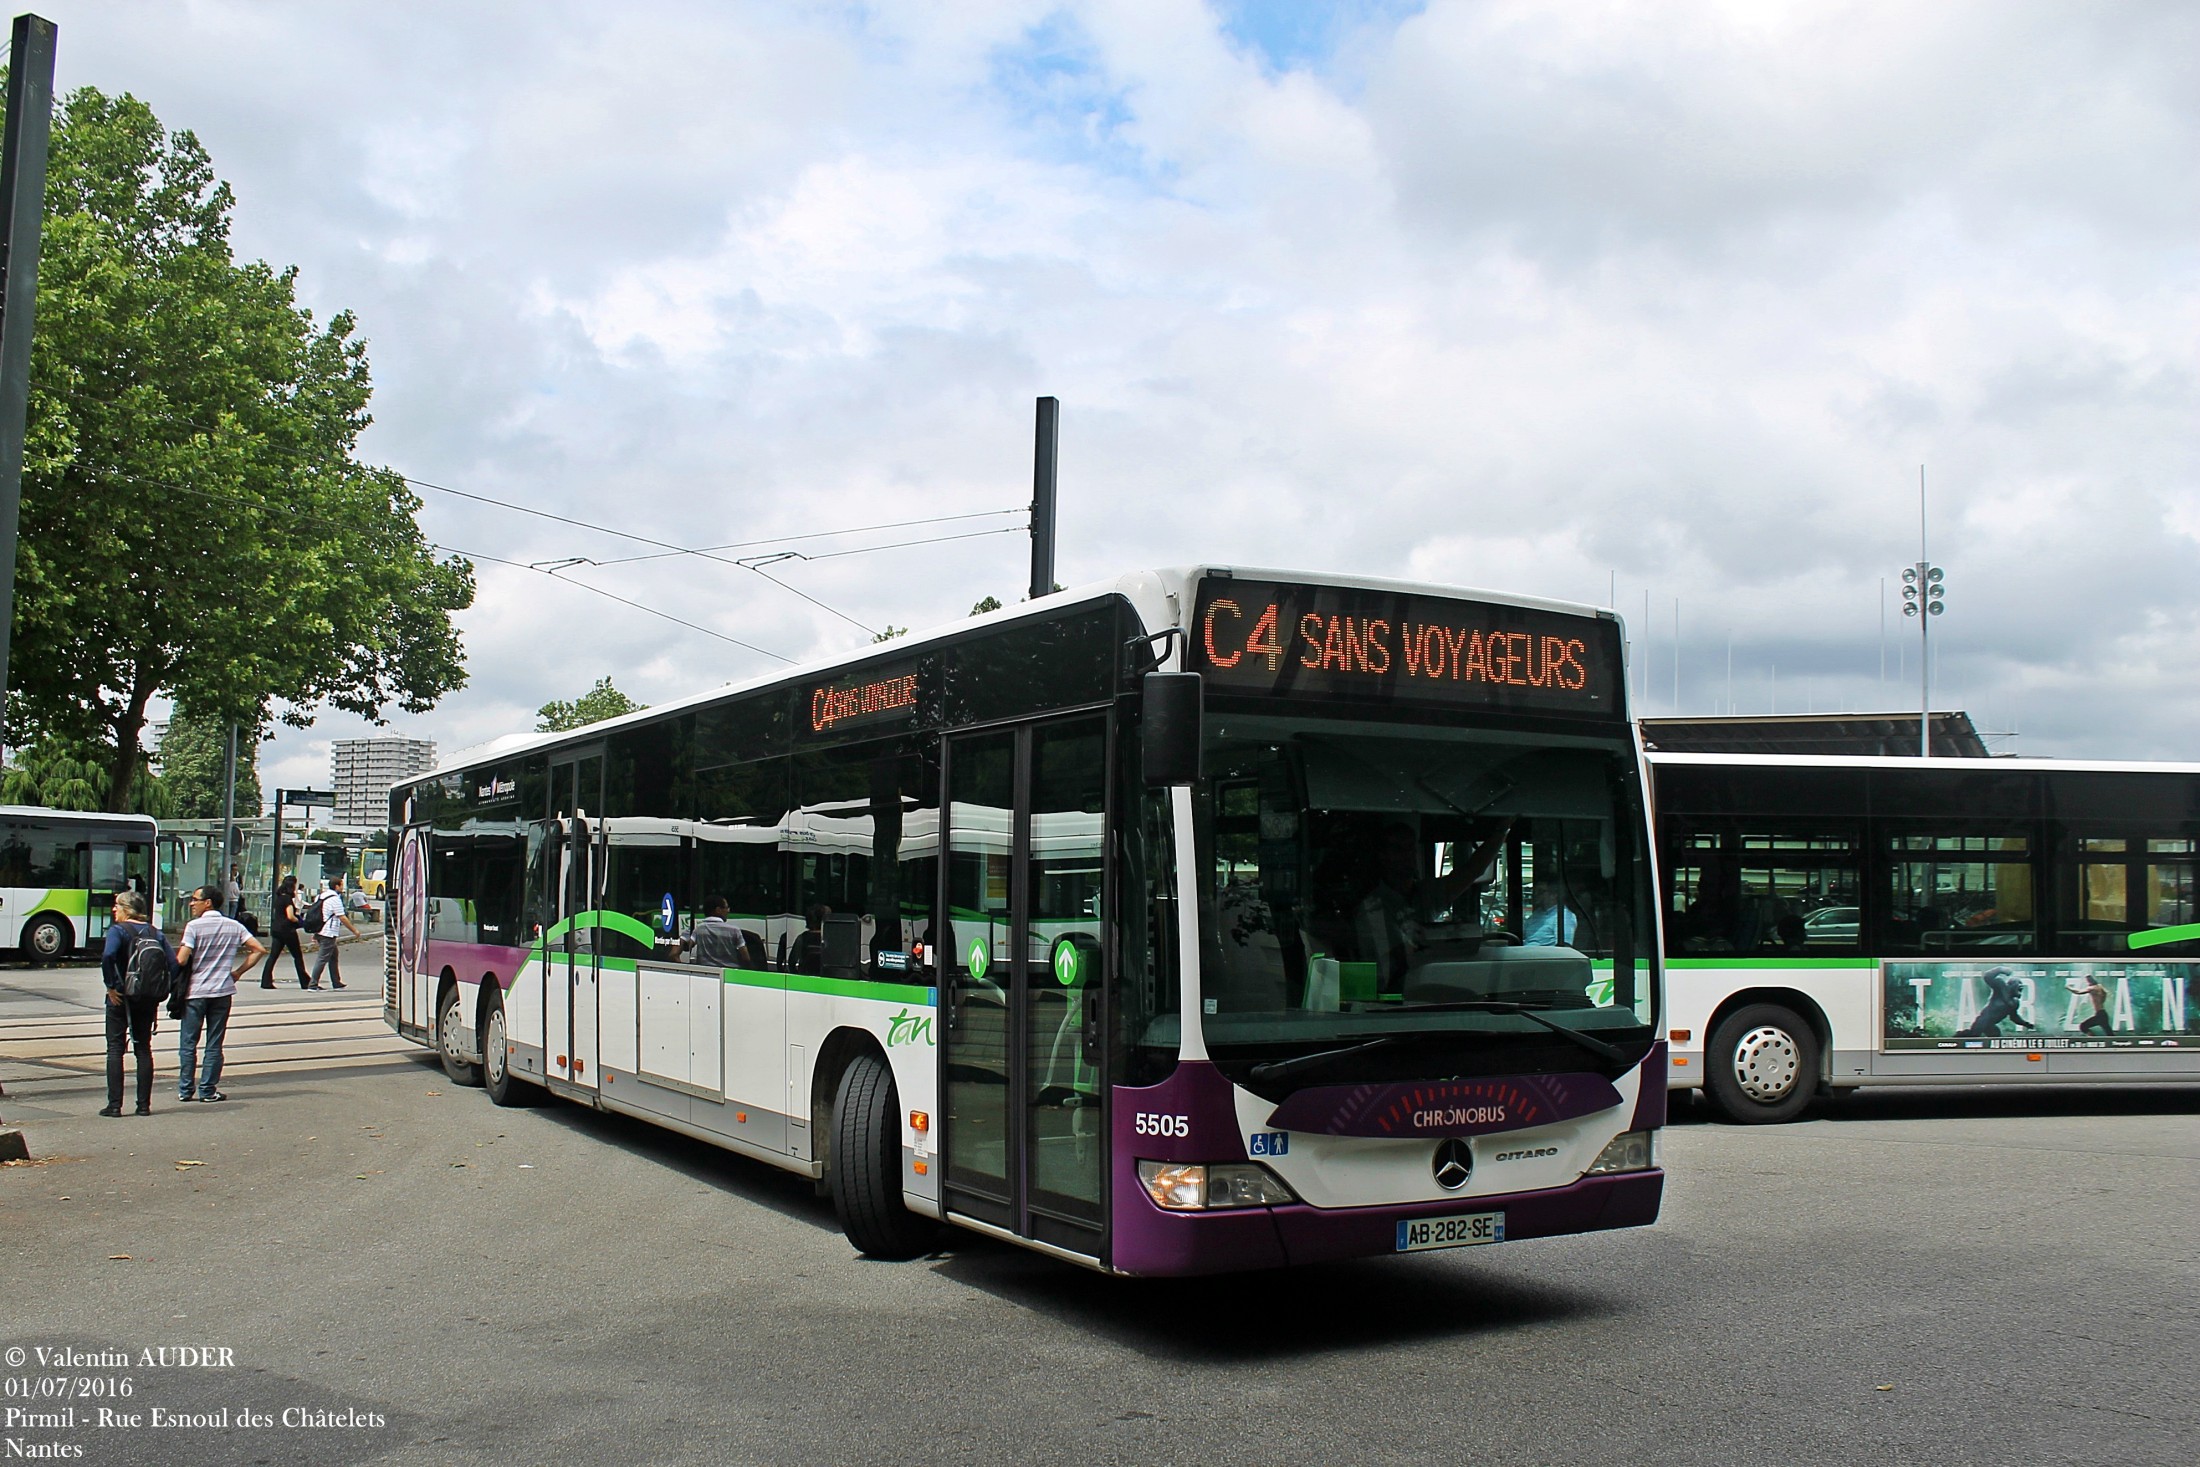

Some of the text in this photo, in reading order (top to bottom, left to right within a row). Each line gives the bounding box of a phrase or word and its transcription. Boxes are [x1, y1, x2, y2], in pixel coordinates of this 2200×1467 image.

[1204, 598, 1585, 690] C4 SANS VOYAGEURS
[812, 686, 835, 731] C4
[1908, 977, 2186, 1032] TARZAN
[886, 1007, 936, 1048] tan
[1990, 1039, 2000, 1049] AU
[2001, 1037, 2027, 1049] CINÉMA
[2028, 1039, 2037, 1049] LE
[2044, 1038, 2069, 1049] JUILLET
[1135, 1112, 1189, 1138] 5505
[1413, 1105, 1506, 1128] CHRONOBUS
[1495, 1147, 1559, 1162] CITARO
[1408, 1217, 1493, 1245] AB-282-SE
